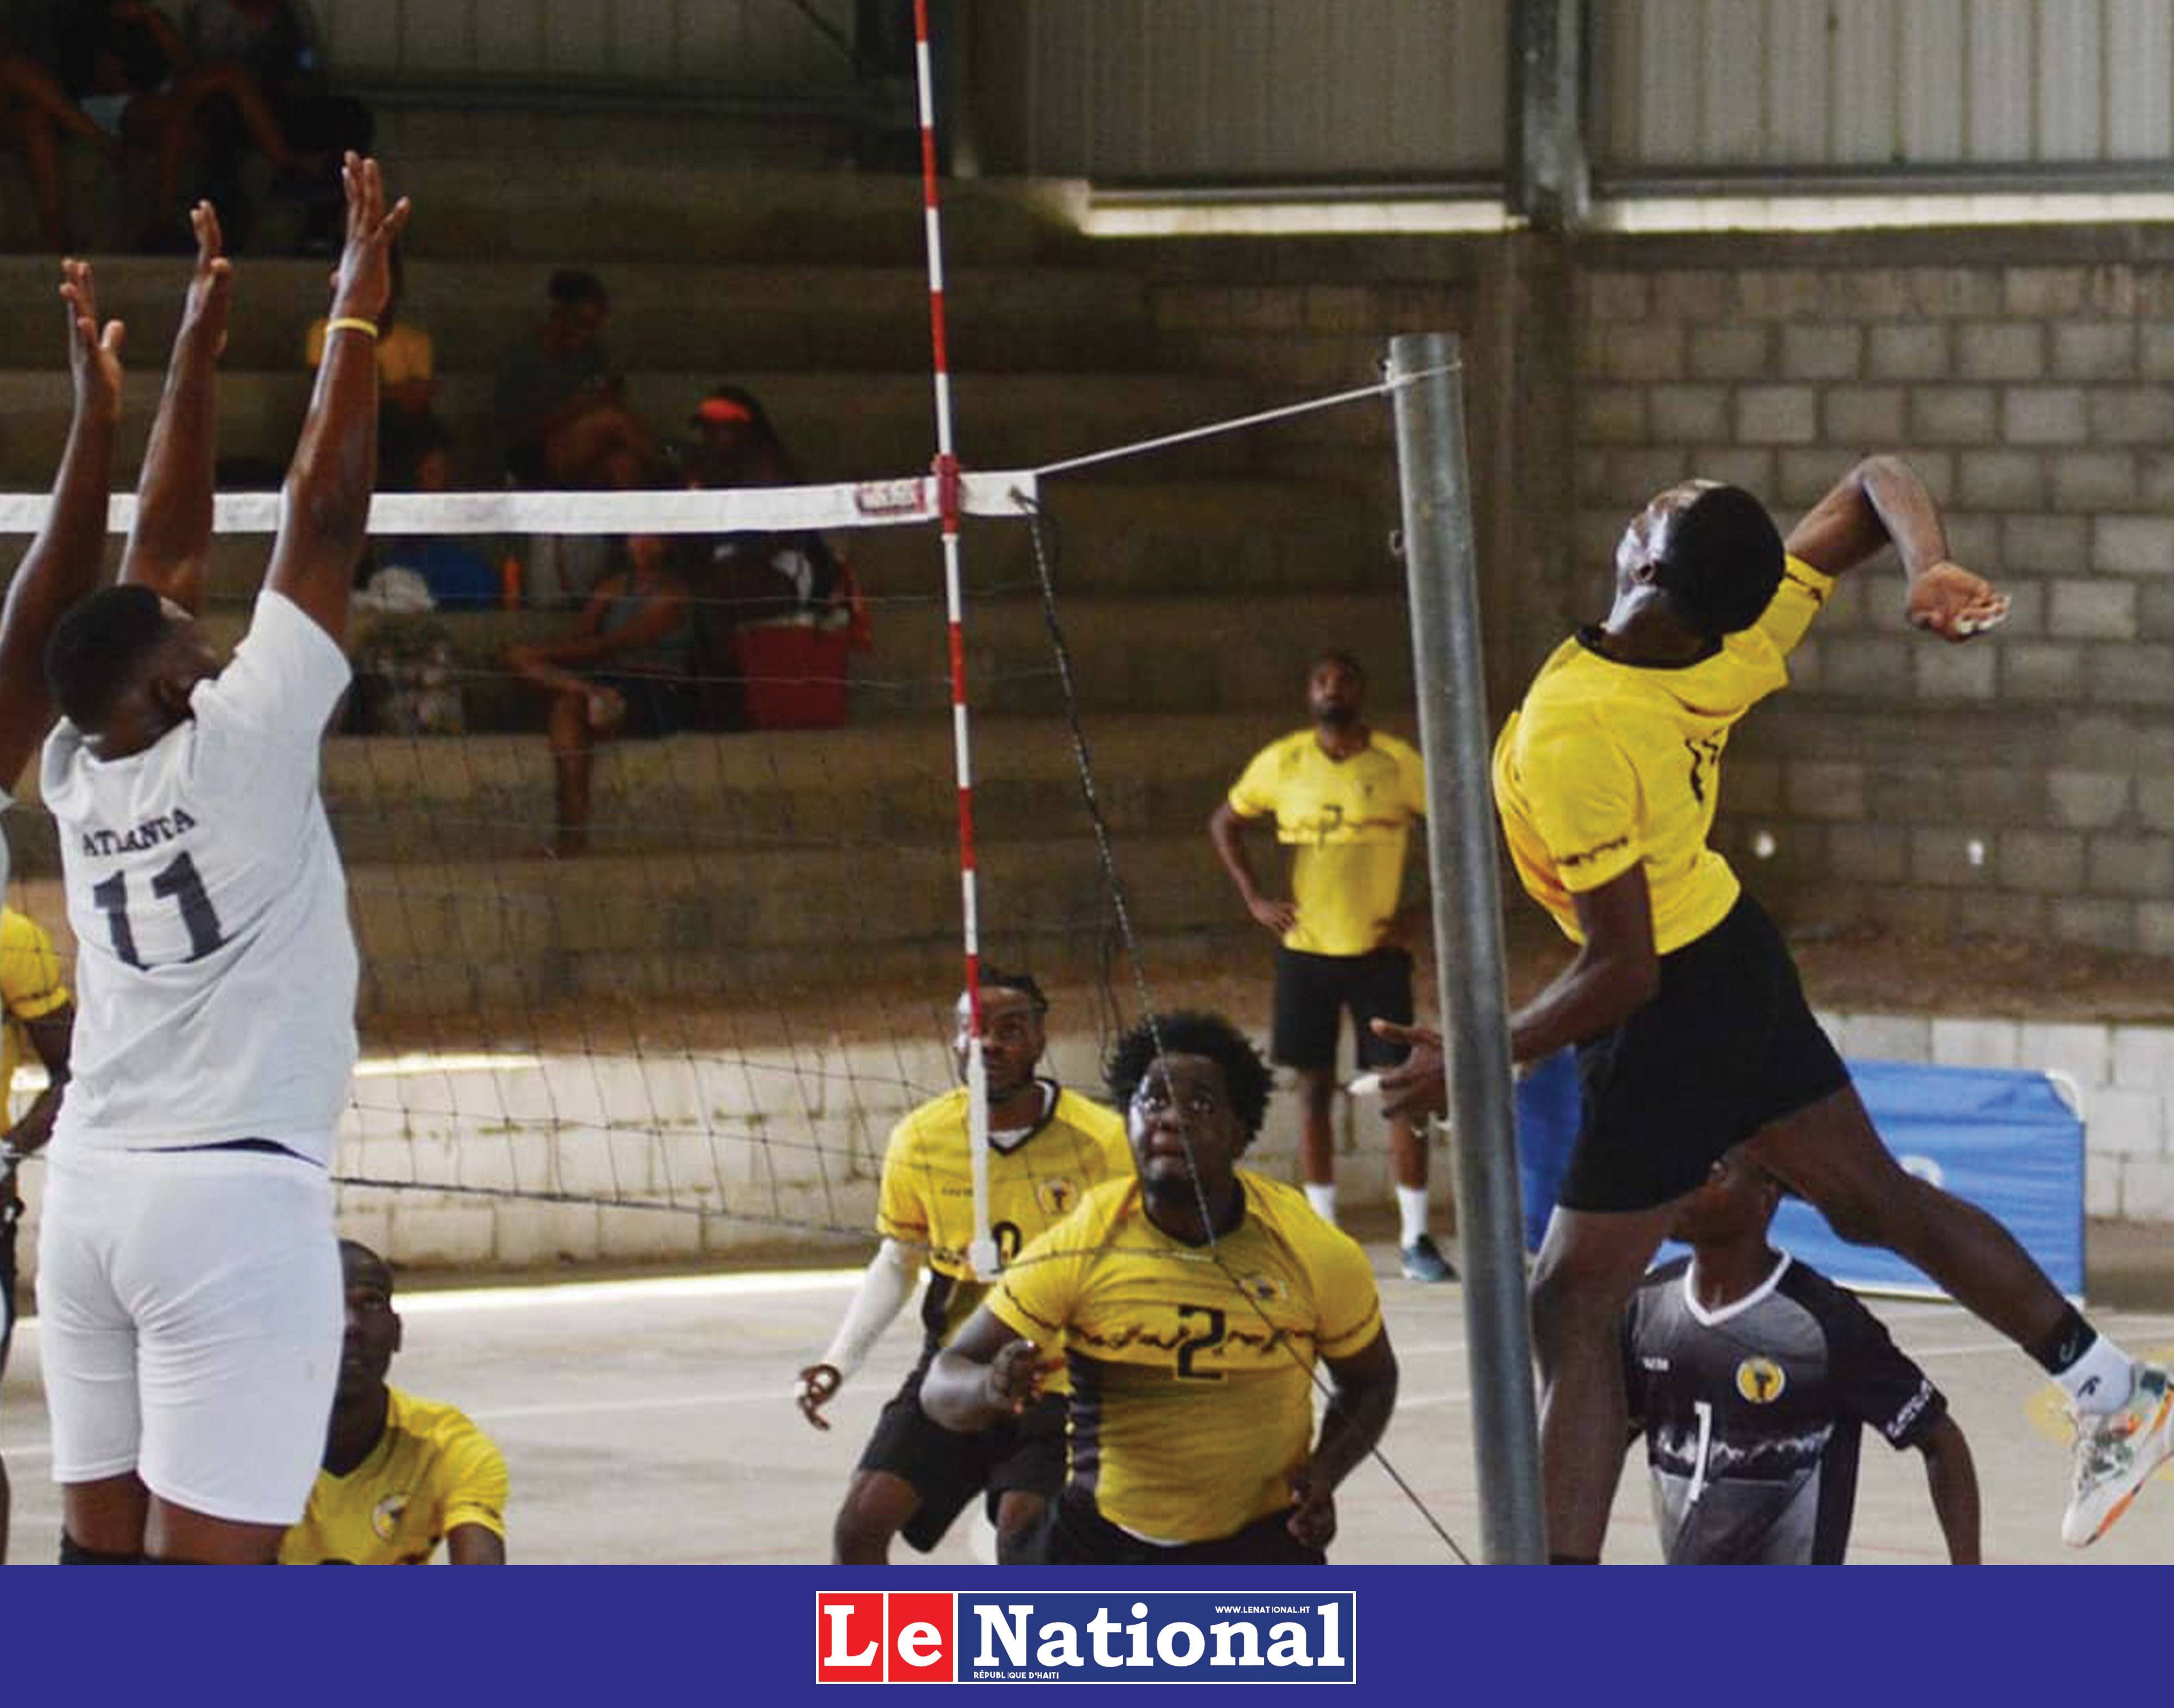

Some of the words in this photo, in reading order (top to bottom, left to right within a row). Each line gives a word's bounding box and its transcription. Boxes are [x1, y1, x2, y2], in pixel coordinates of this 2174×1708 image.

[83, 807, 196, 856] ATLANTA
[93, 850, 222, 972] 11
[1177, 1304, 1226, 1379] 2
